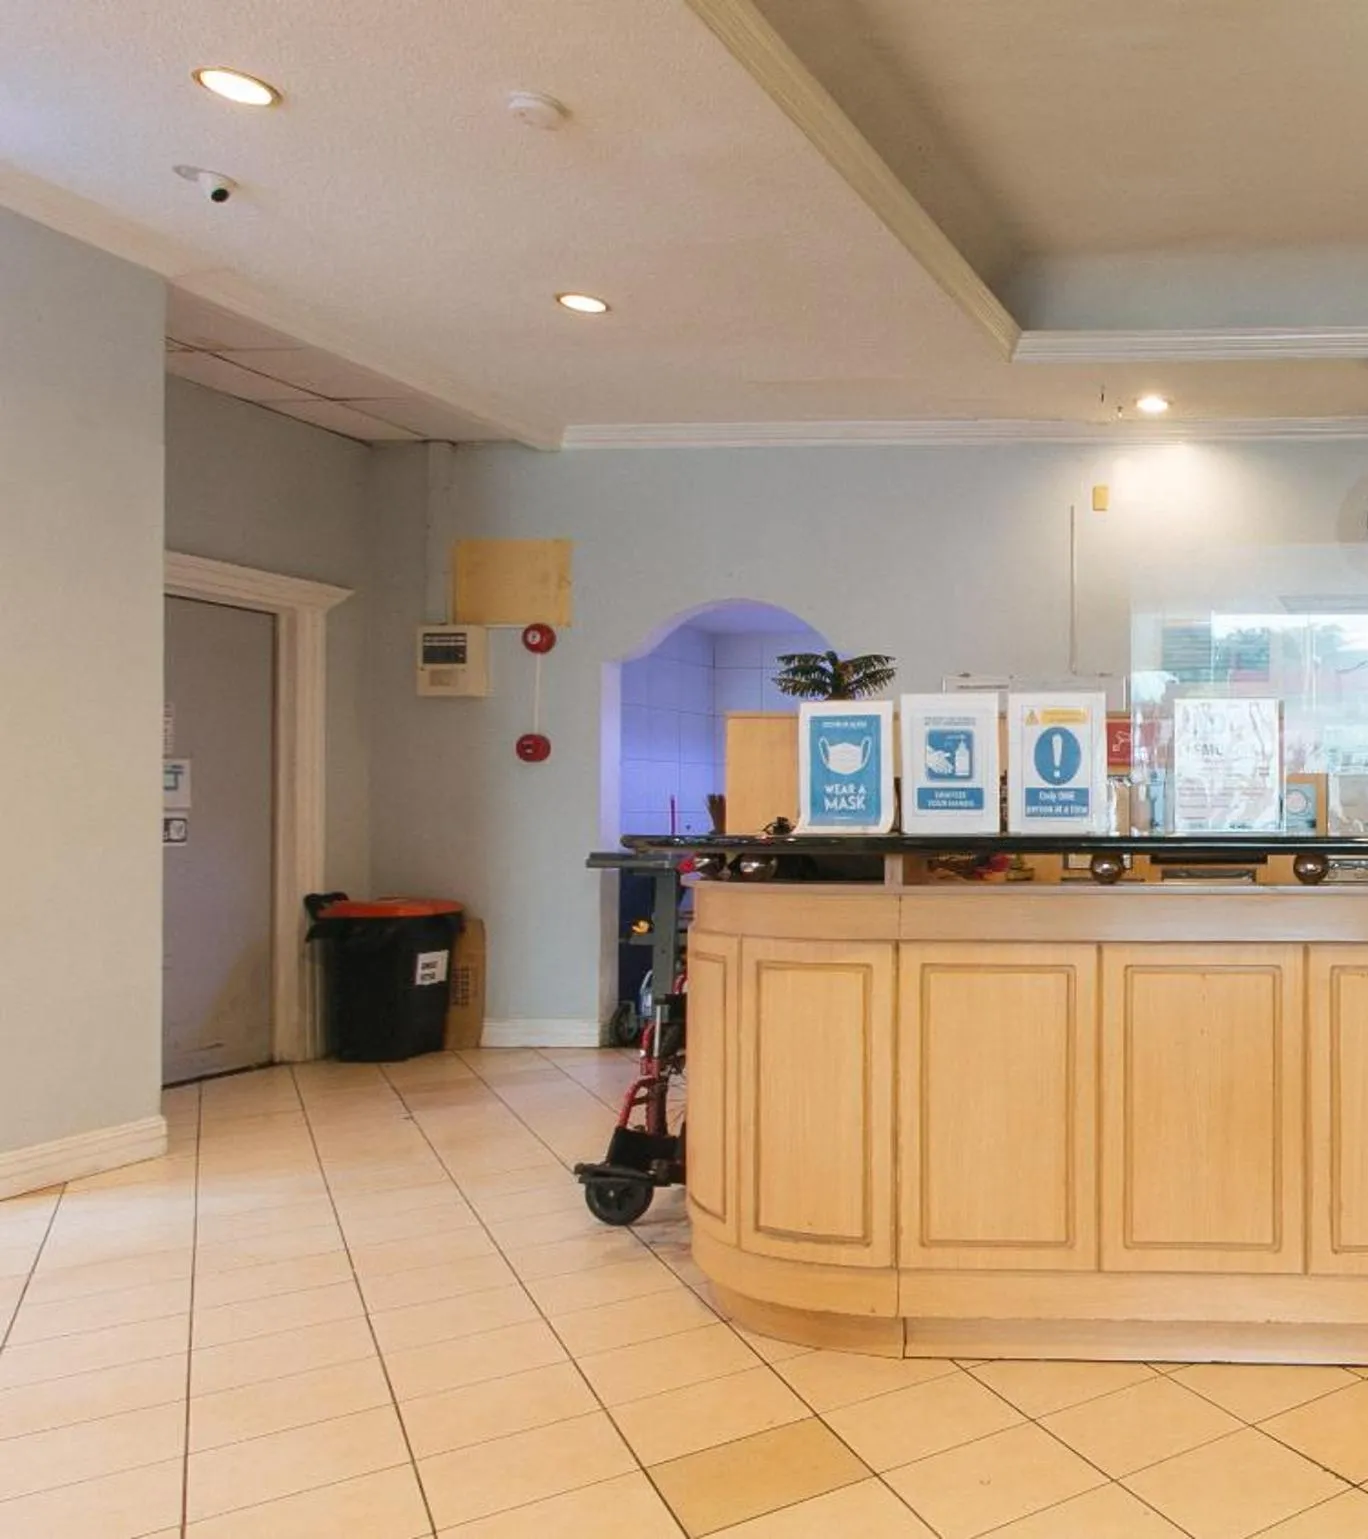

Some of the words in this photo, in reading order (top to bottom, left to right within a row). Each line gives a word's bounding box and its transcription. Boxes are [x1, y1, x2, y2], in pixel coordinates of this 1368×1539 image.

[824, 784, 856, 794] WEAR
[858, 784, 867, 794] A
[824, 795, 866, 811] MASK
[1039, 791, 1057, 803] Only
